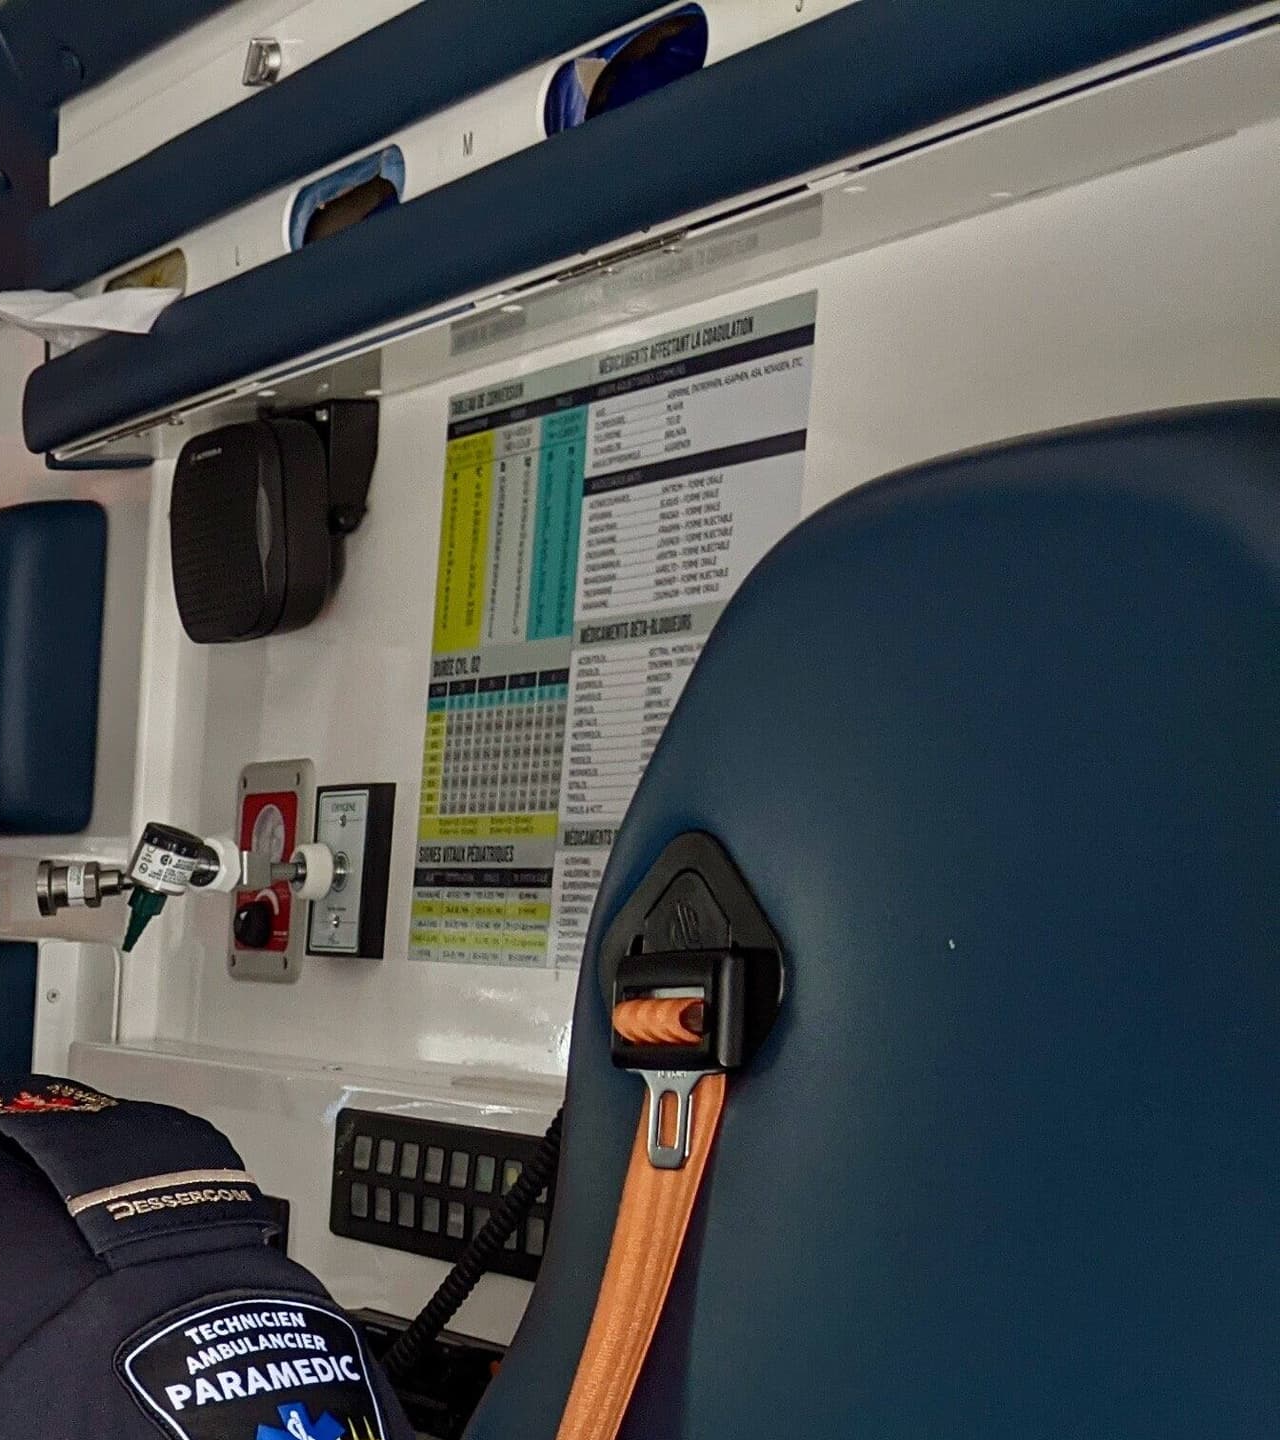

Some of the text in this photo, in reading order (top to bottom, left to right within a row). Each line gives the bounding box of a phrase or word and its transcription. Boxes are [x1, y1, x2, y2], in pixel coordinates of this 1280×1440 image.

[462, 131, 473, 157] M
[691, 331, 701, 350] LA
[702, 316, 754, 347] COAGULATION
[184, 1311, 307, 1345] TECHNICIEN
[185, 1333, 328, 1376] AMBULANCIER
[165, 1354, 361, 1411] PARAMEDIC
